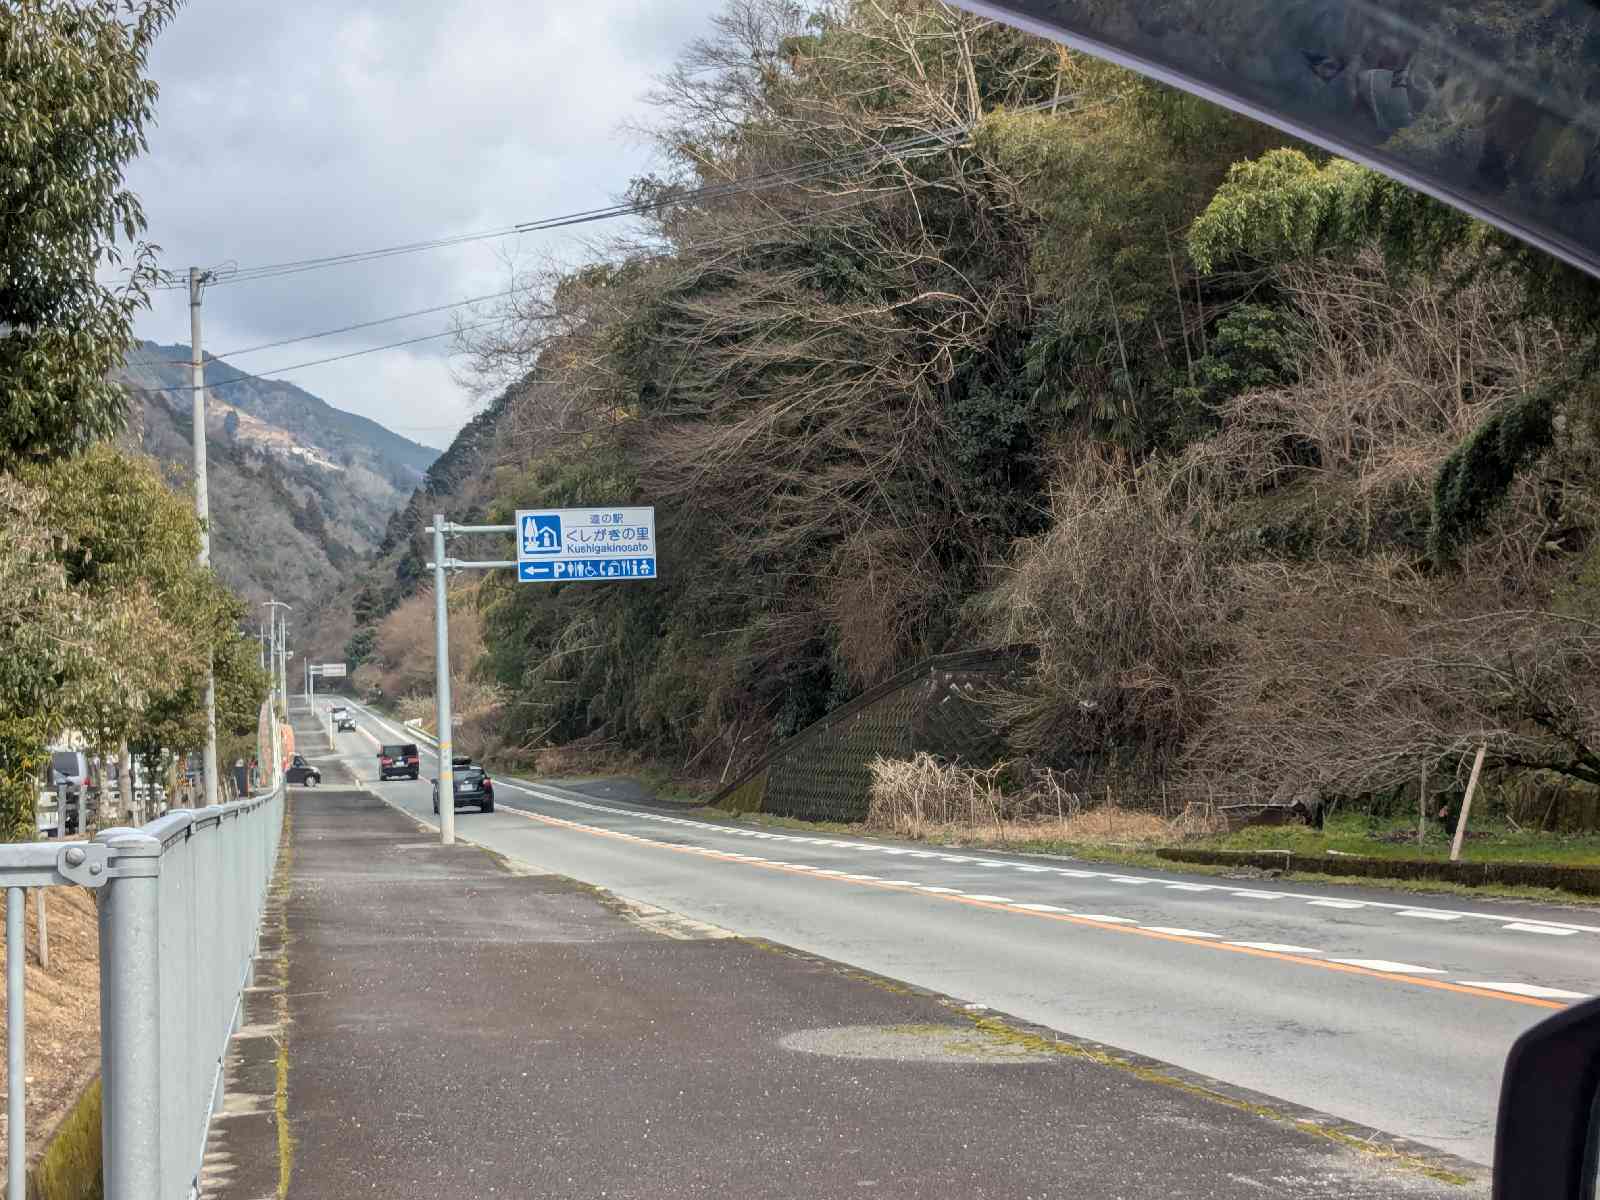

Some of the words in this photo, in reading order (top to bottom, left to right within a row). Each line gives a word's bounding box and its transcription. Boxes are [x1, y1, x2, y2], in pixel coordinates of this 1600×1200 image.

[590, 513, 624, 524] 道の駅
[566, 527, 649, 542] くしがきの里
[567, 543, 649, 554] Kushigakinosato
